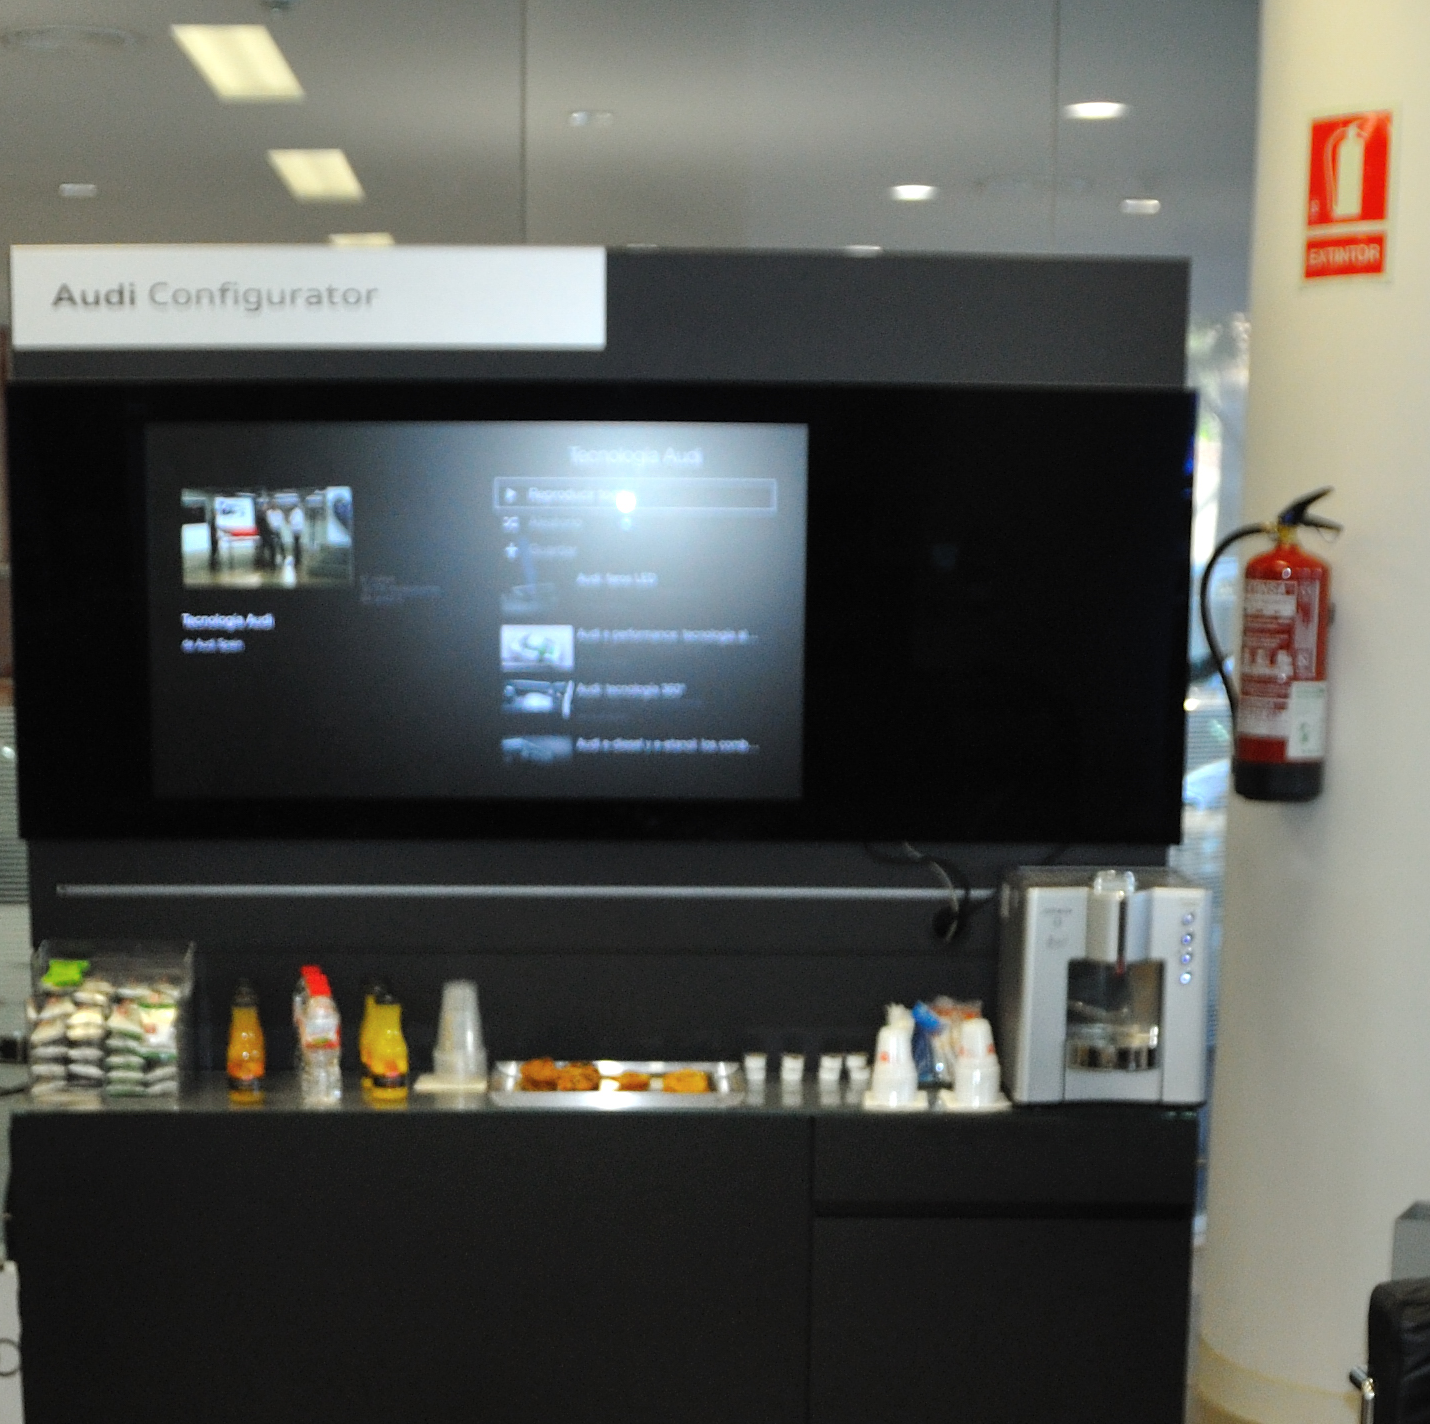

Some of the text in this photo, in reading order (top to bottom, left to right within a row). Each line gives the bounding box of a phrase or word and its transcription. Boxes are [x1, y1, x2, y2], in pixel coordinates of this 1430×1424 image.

[1309, 243, 1381, 266] EXTINTOR
[51, 281, 379, 313] Audi Configurator
[662, 446, 704, 466] Audi
[245, 612, 275, 630] Audi
